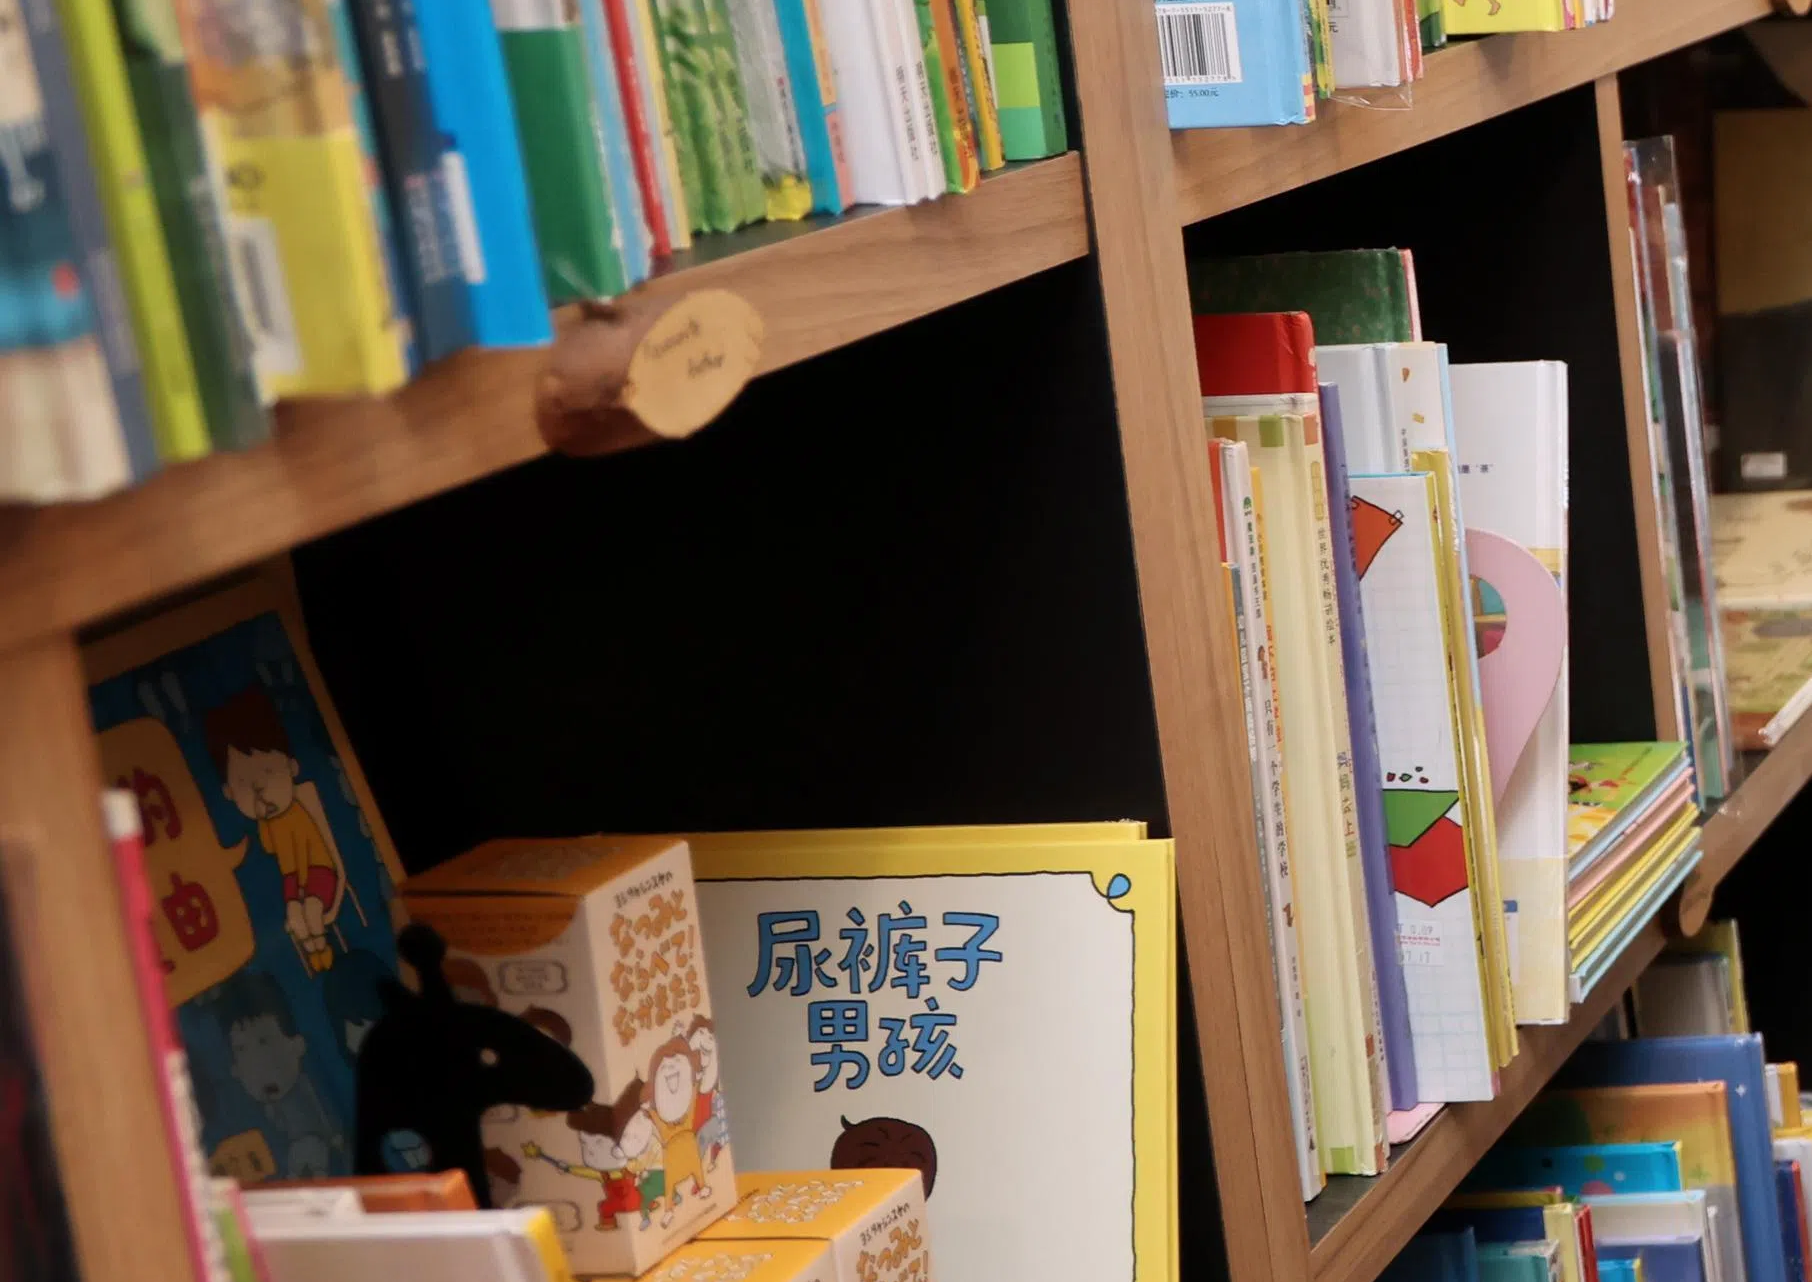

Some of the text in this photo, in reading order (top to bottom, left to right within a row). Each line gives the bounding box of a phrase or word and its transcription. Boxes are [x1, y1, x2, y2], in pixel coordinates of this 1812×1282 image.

[746, 900, 1003, 998] 尿裤子
[807, 997, 964, 1092] 男孩
